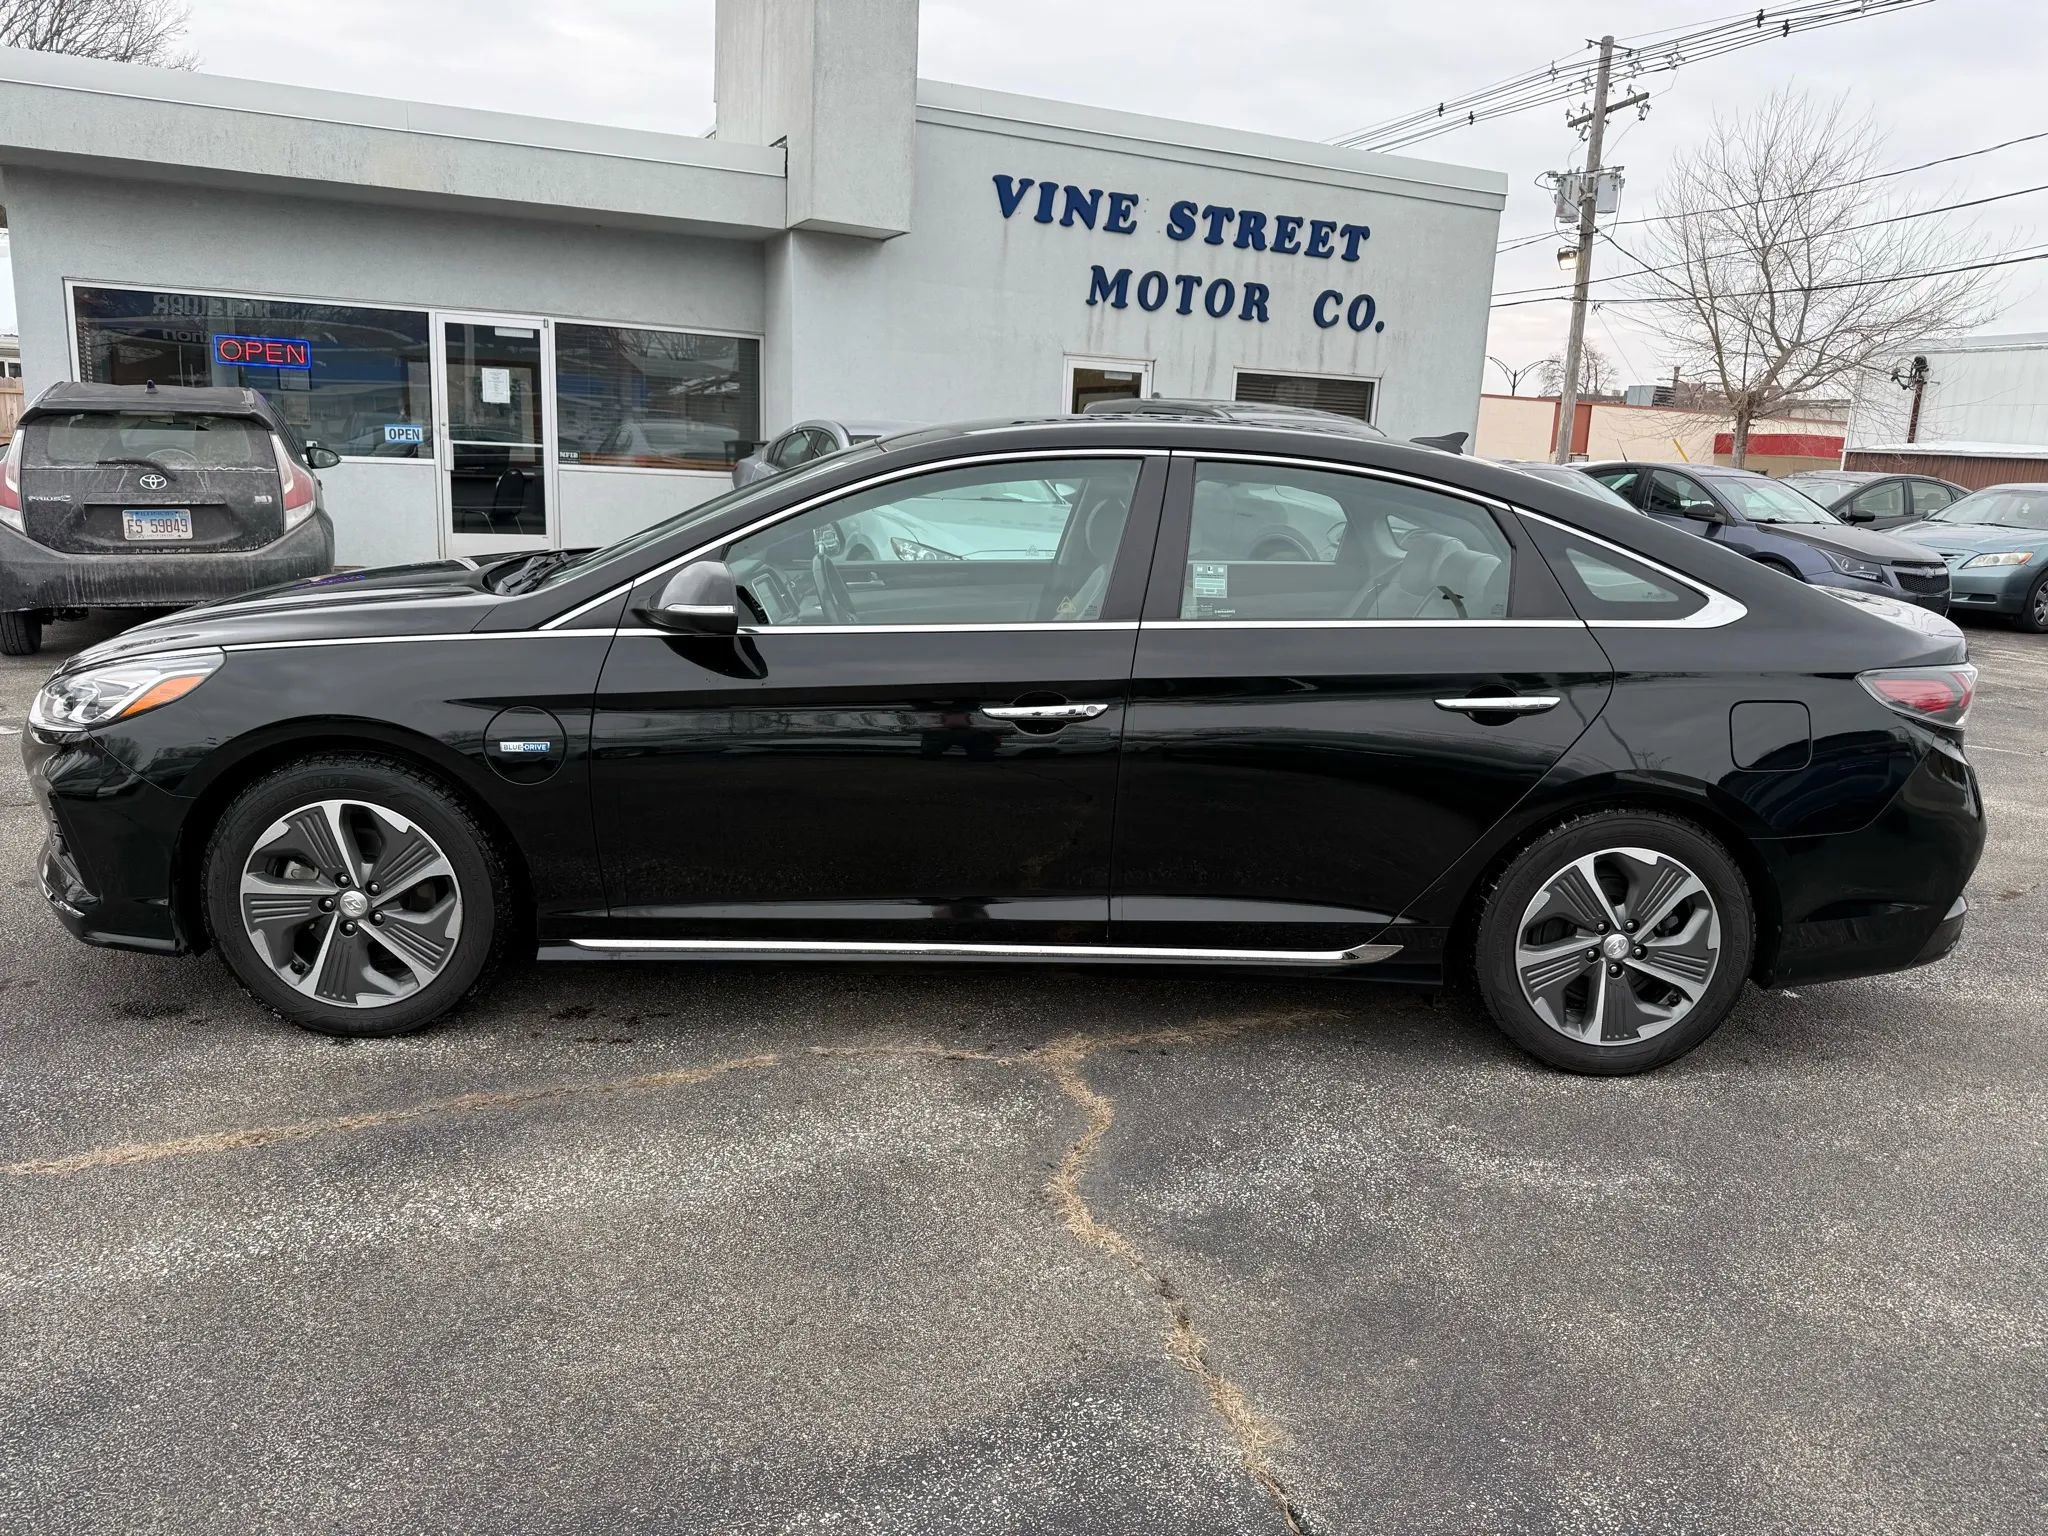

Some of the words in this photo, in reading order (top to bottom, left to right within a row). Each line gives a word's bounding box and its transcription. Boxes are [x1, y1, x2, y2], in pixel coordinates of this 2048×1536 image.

[992, 174, 1139, 235] VINE
[1166, 200, 1370, 262] STREET
[1085, 265, 1270, 323] MOTOR
[1313, 289, 1385, 333] CO.
[219, 339, 305, 364] OPEN
[388, 428, 420, 441] OPEN
[150, 518, 189, 534] 59849
